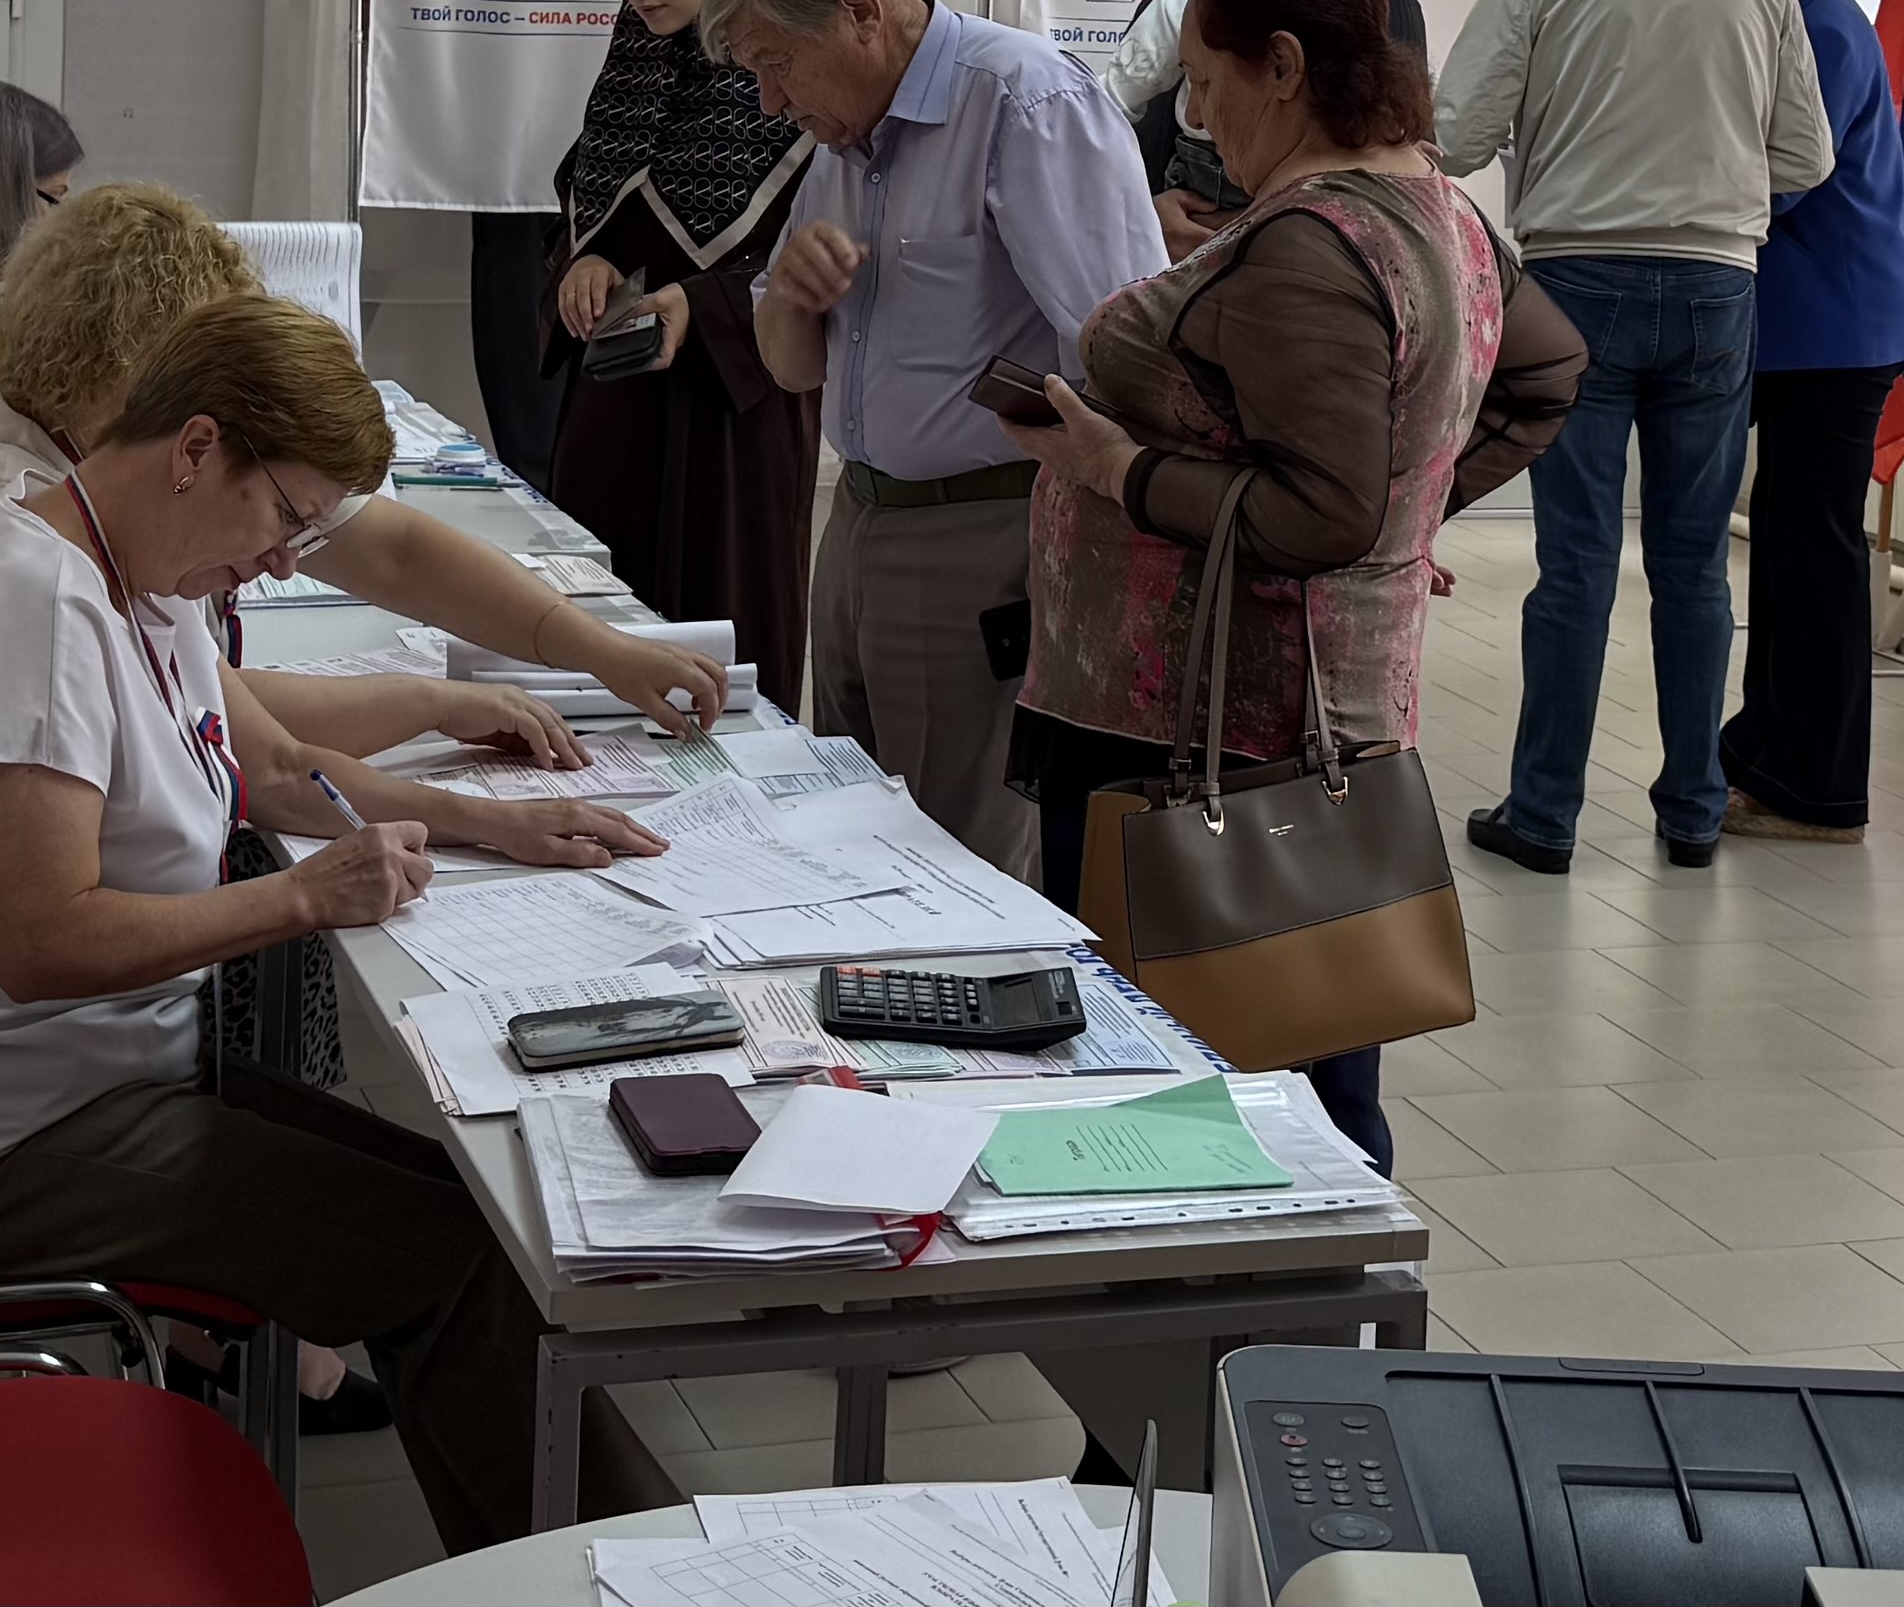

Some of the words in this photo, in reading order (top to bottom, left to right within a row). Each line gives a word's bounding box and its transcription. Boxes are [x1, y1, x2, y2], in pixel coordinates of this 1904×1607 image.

[411, 6, 451, 21] ТВОЙ
[455, 9, 511, 23] ГОЛОС
[529, 12, 572, 25] СИЛА
